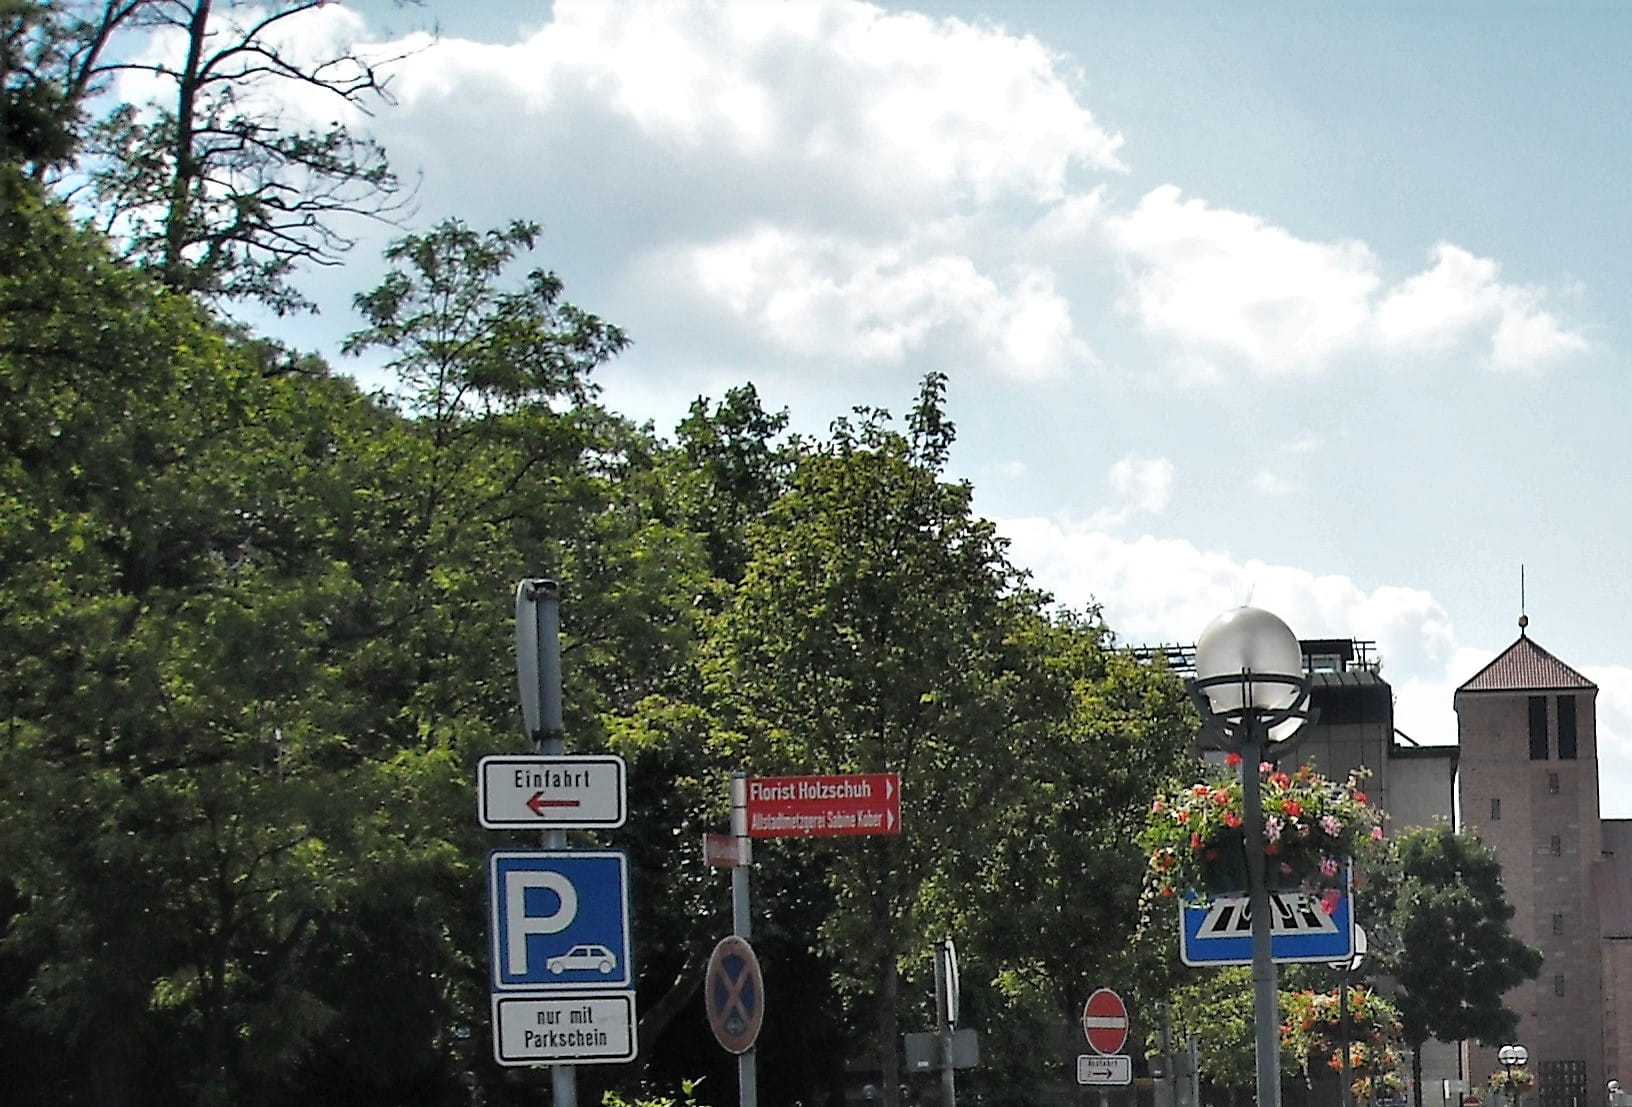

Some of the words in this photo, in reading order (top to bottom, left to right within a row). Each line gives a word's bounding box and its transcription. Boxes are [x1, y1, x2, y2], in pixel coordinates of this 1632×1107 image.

[514, 769, 591, 789] Einfahrt
[750, 782, 796, 801] Florist
[798, 780, 871, 800] Holzschuh
[505, 870, 578, 976] P
[537, 1009, 561, 1026] nur
[570, 1005, 593, 1025] mit
[524, 1028, 608, 1049] Parkschein
